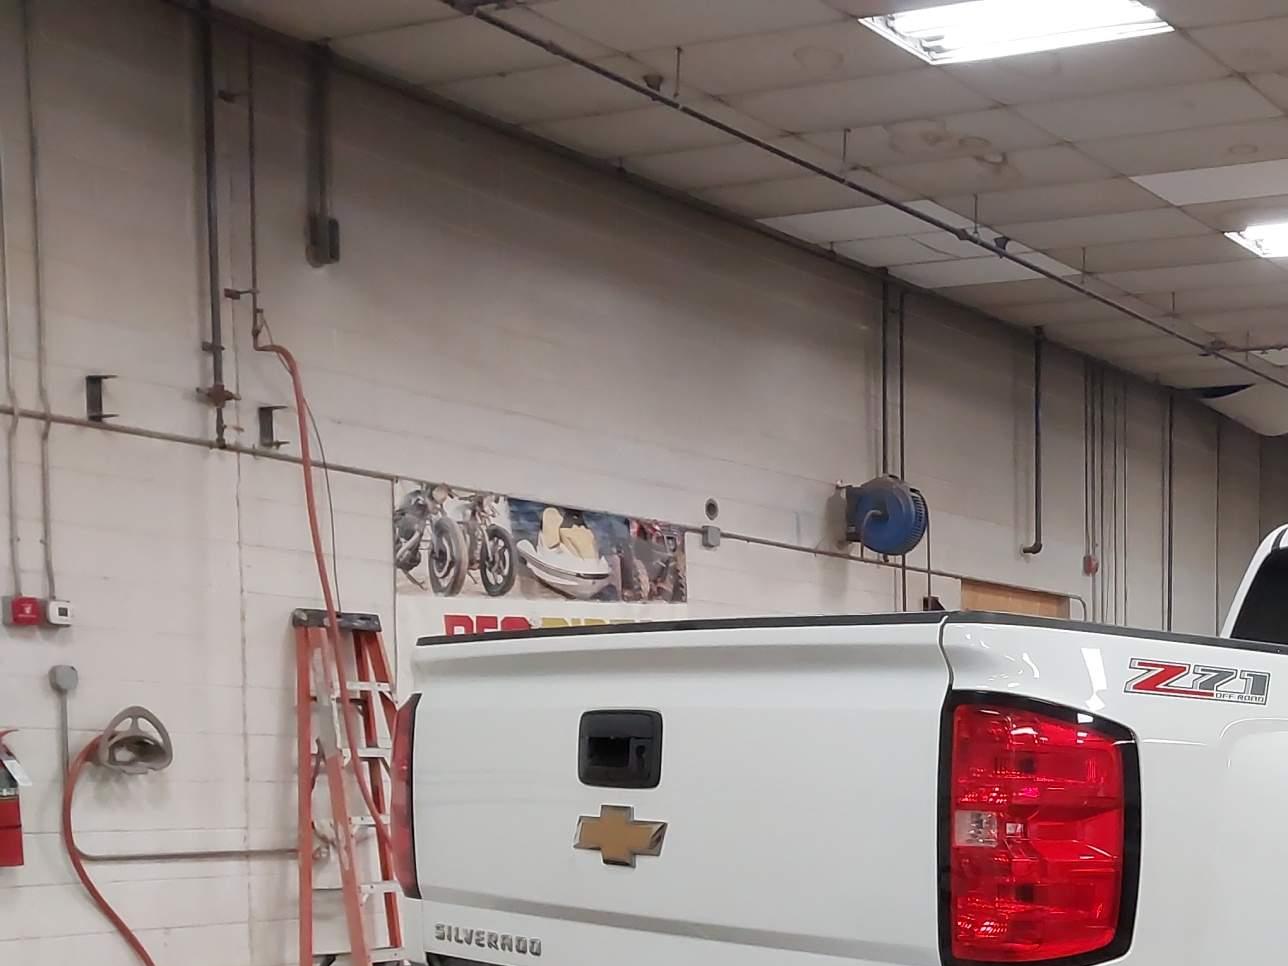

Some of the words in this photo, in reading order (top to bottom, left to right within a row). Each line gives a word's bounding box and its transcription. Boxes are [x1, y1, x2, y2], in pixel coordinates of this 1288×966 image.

[1124, 657, 1271, 704] Z71
[1215, 692, 1234, 700] OFF
[434, 922, 542, 957] SILVERADO
